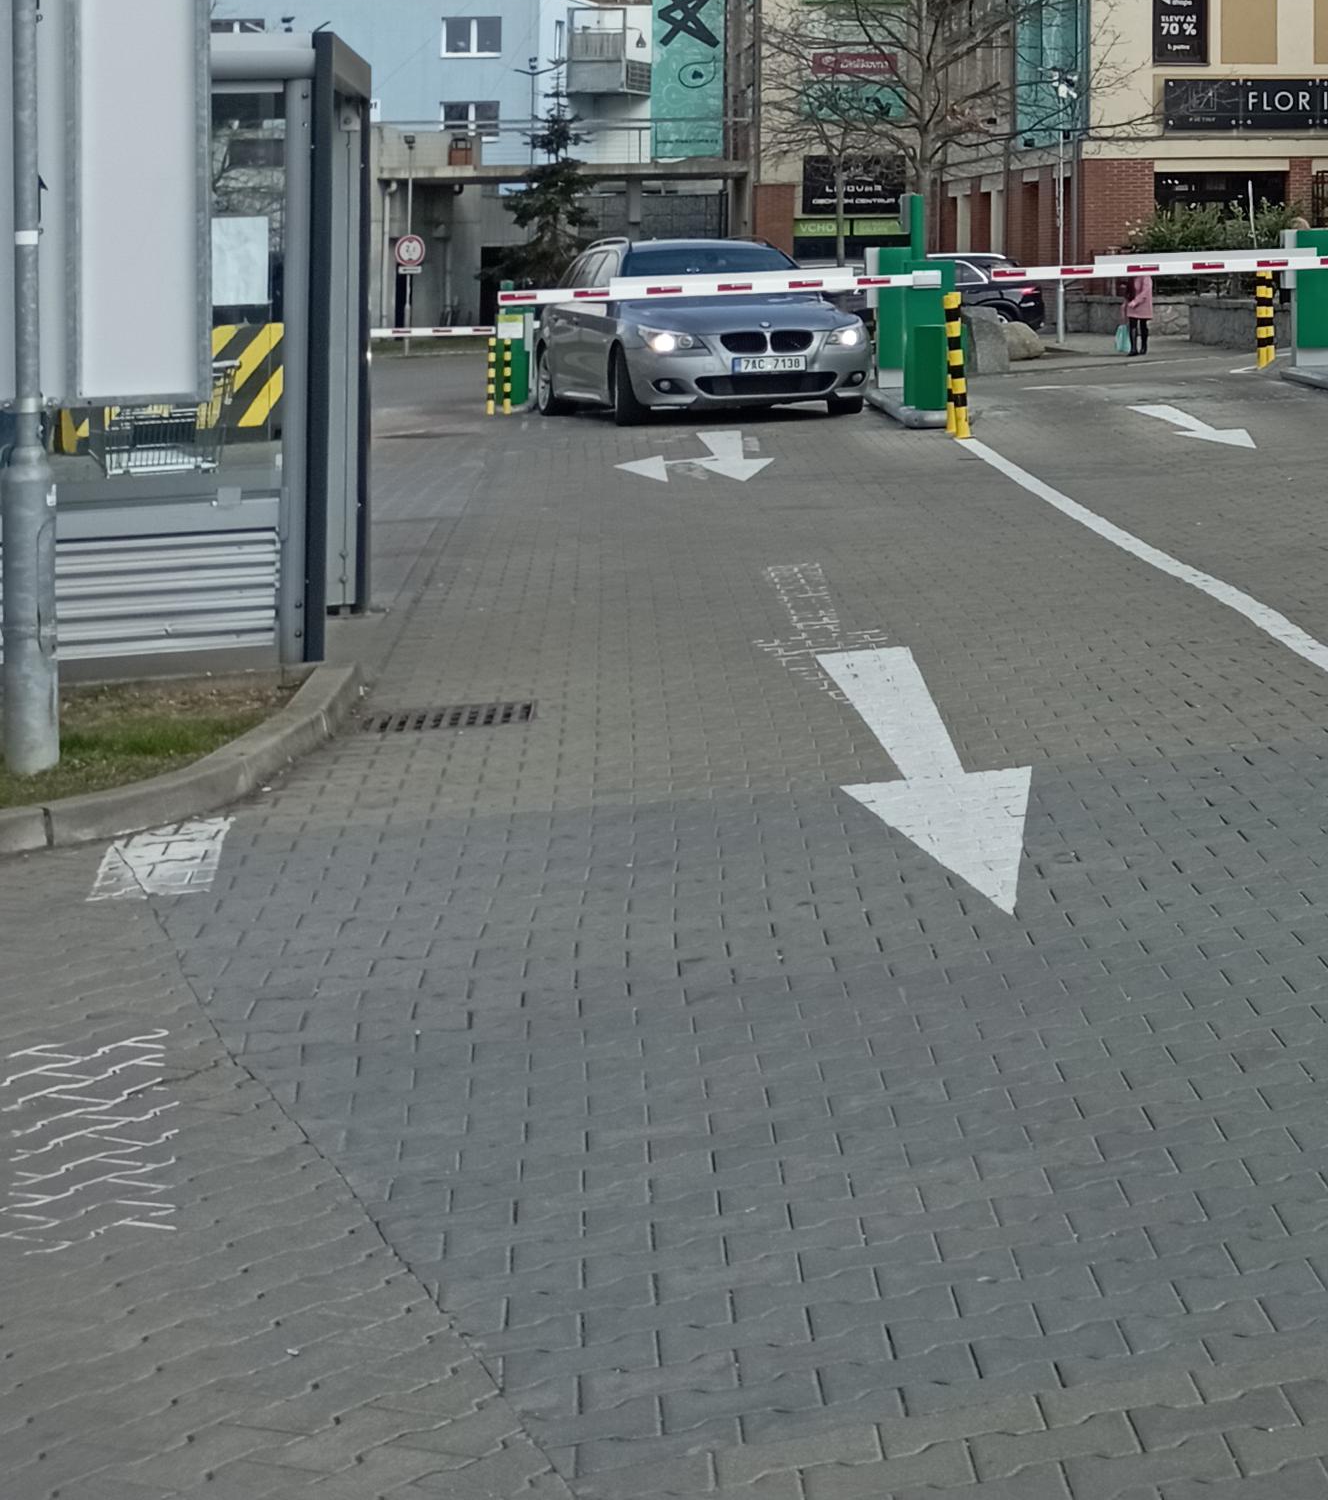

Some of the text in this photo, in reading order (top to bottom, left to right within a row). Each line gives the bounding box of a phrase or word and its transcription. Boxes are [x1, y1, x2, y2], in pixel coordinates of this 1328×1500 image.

[1161, 23, 1197, 35] 70 %
[744, 358, 800, 370] 7AC 7138
